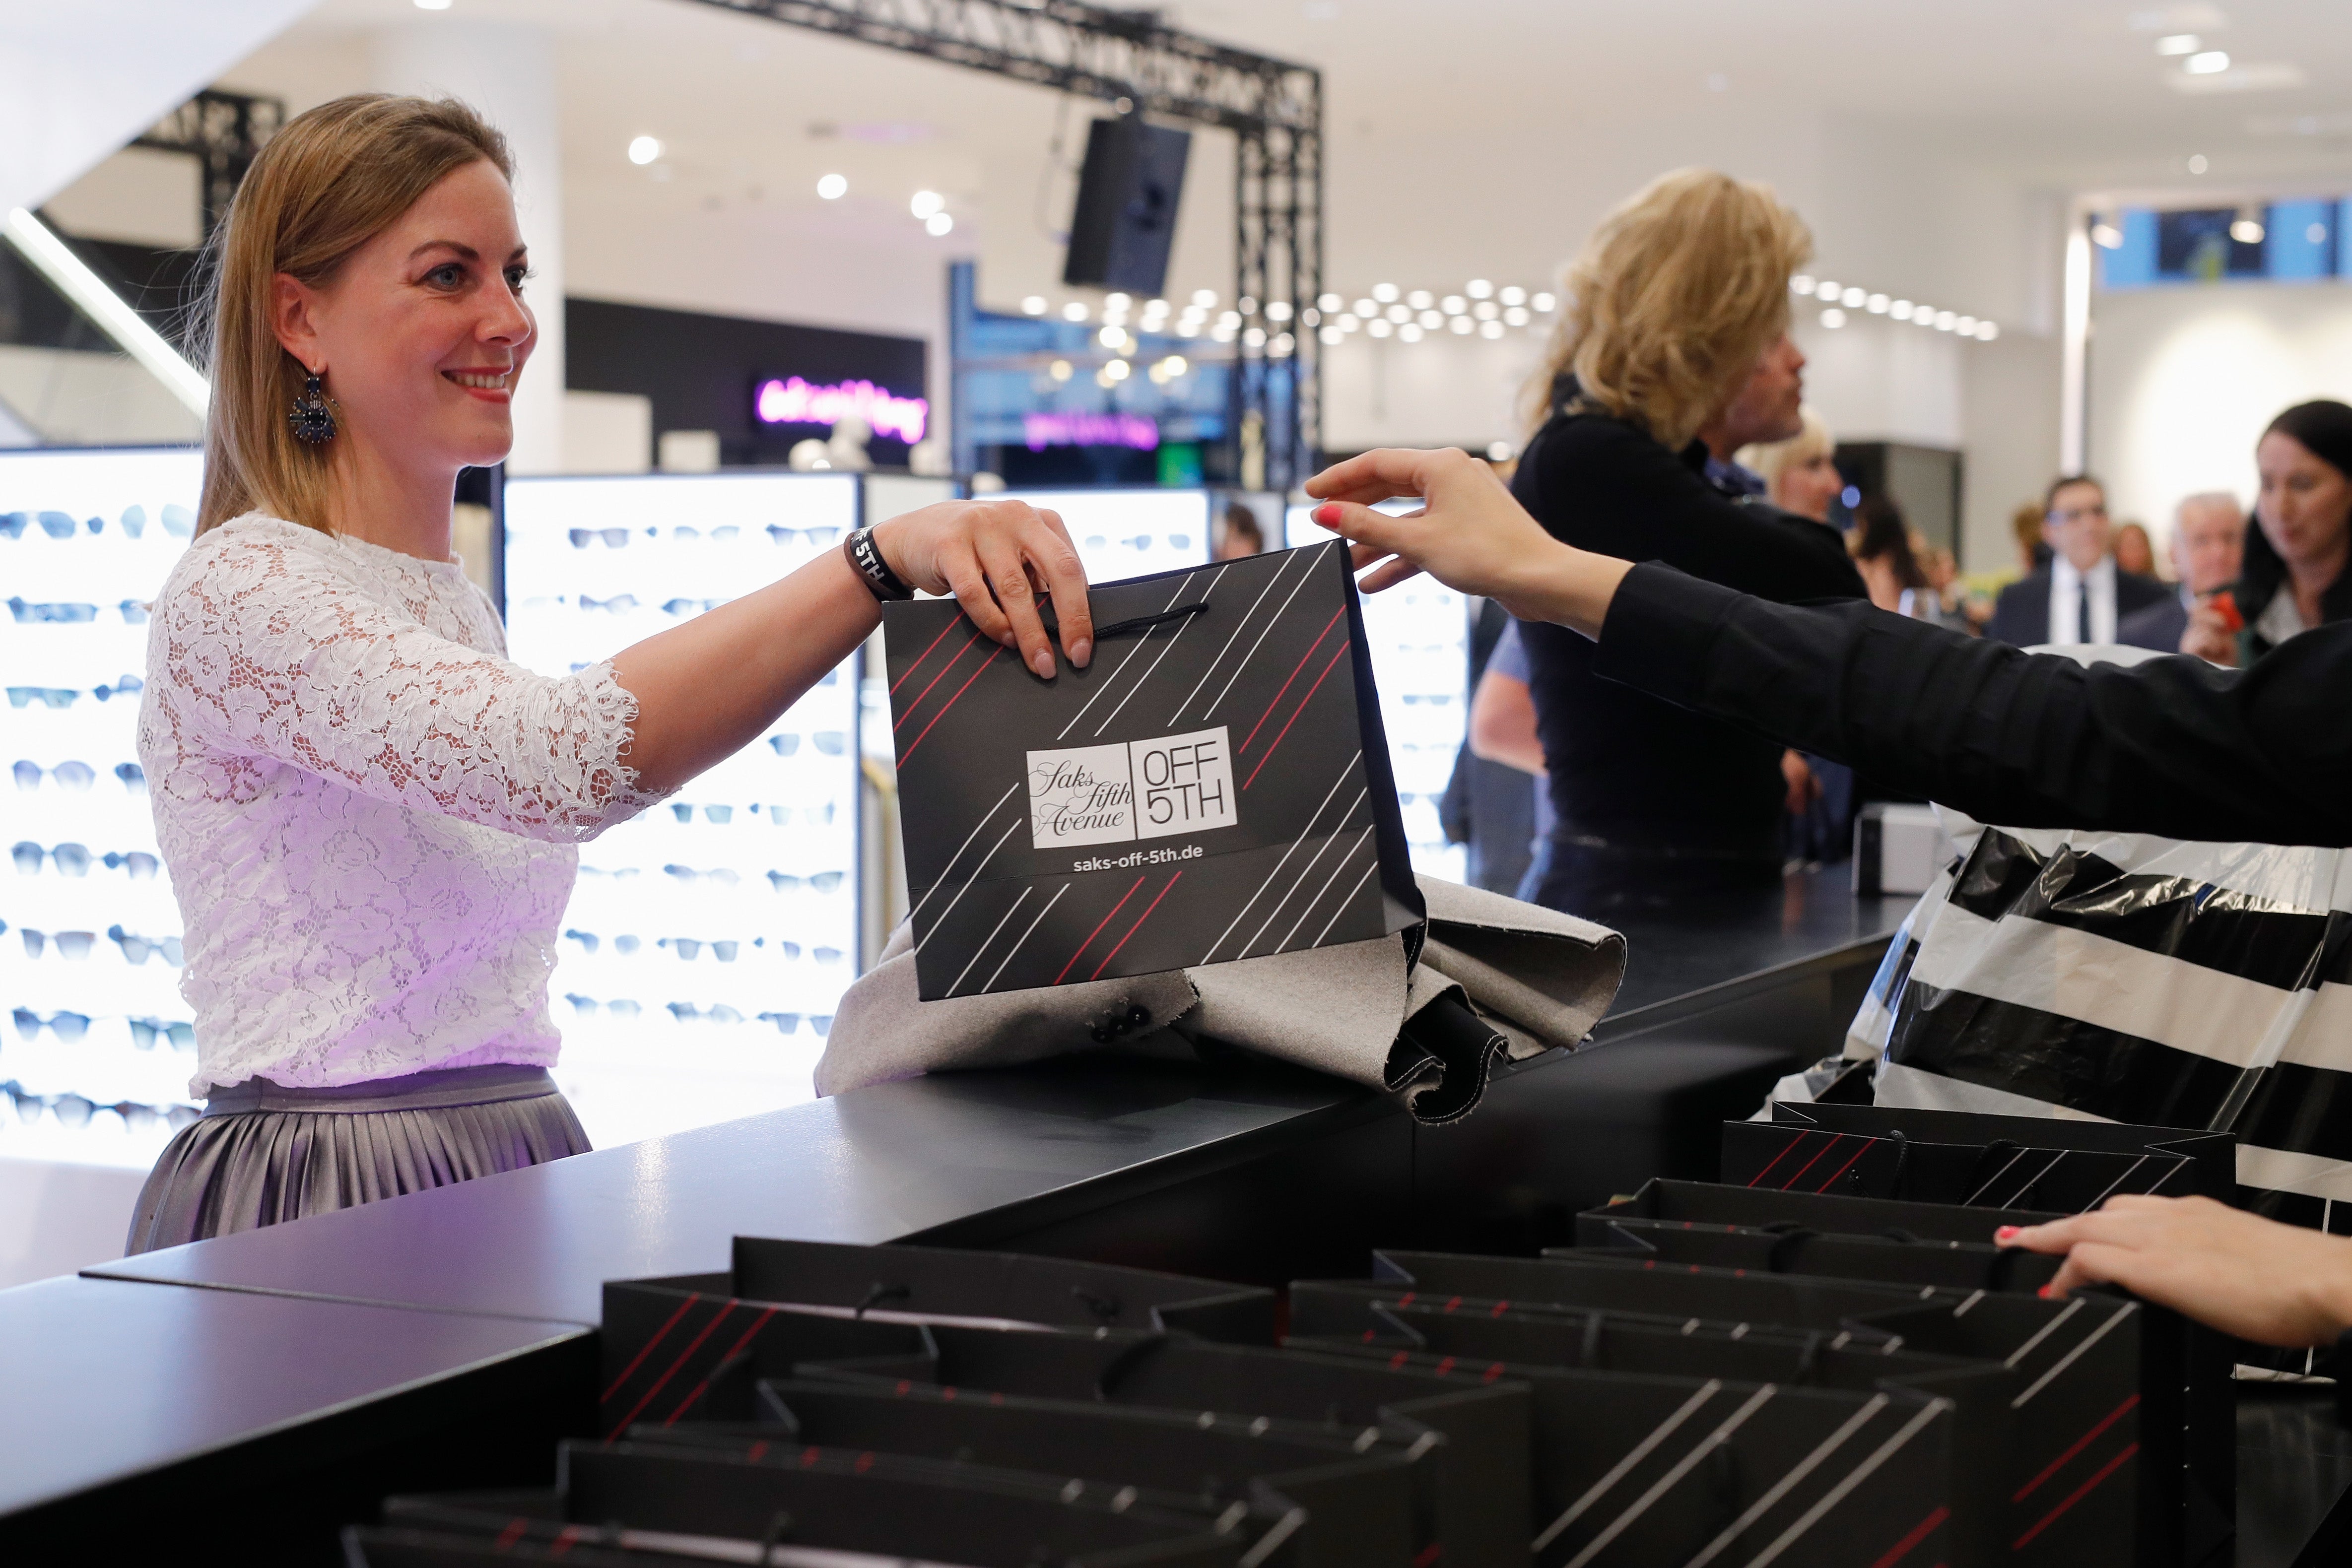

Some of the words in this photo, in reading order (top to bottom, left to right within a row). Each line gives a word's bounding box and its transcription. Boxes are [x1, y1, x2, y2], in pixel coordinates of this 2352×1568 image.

[855, 541, 885, 581] 5TH
[1028, 760, 1093, 797] Saks
[1143, 741, 1218, 786] OFF
[1032, 803, 1124, 837] Avenue
[1147, 778, 1224, 824] 5TH
[1074, 845, 1203, 872] saks-off-5th.de
